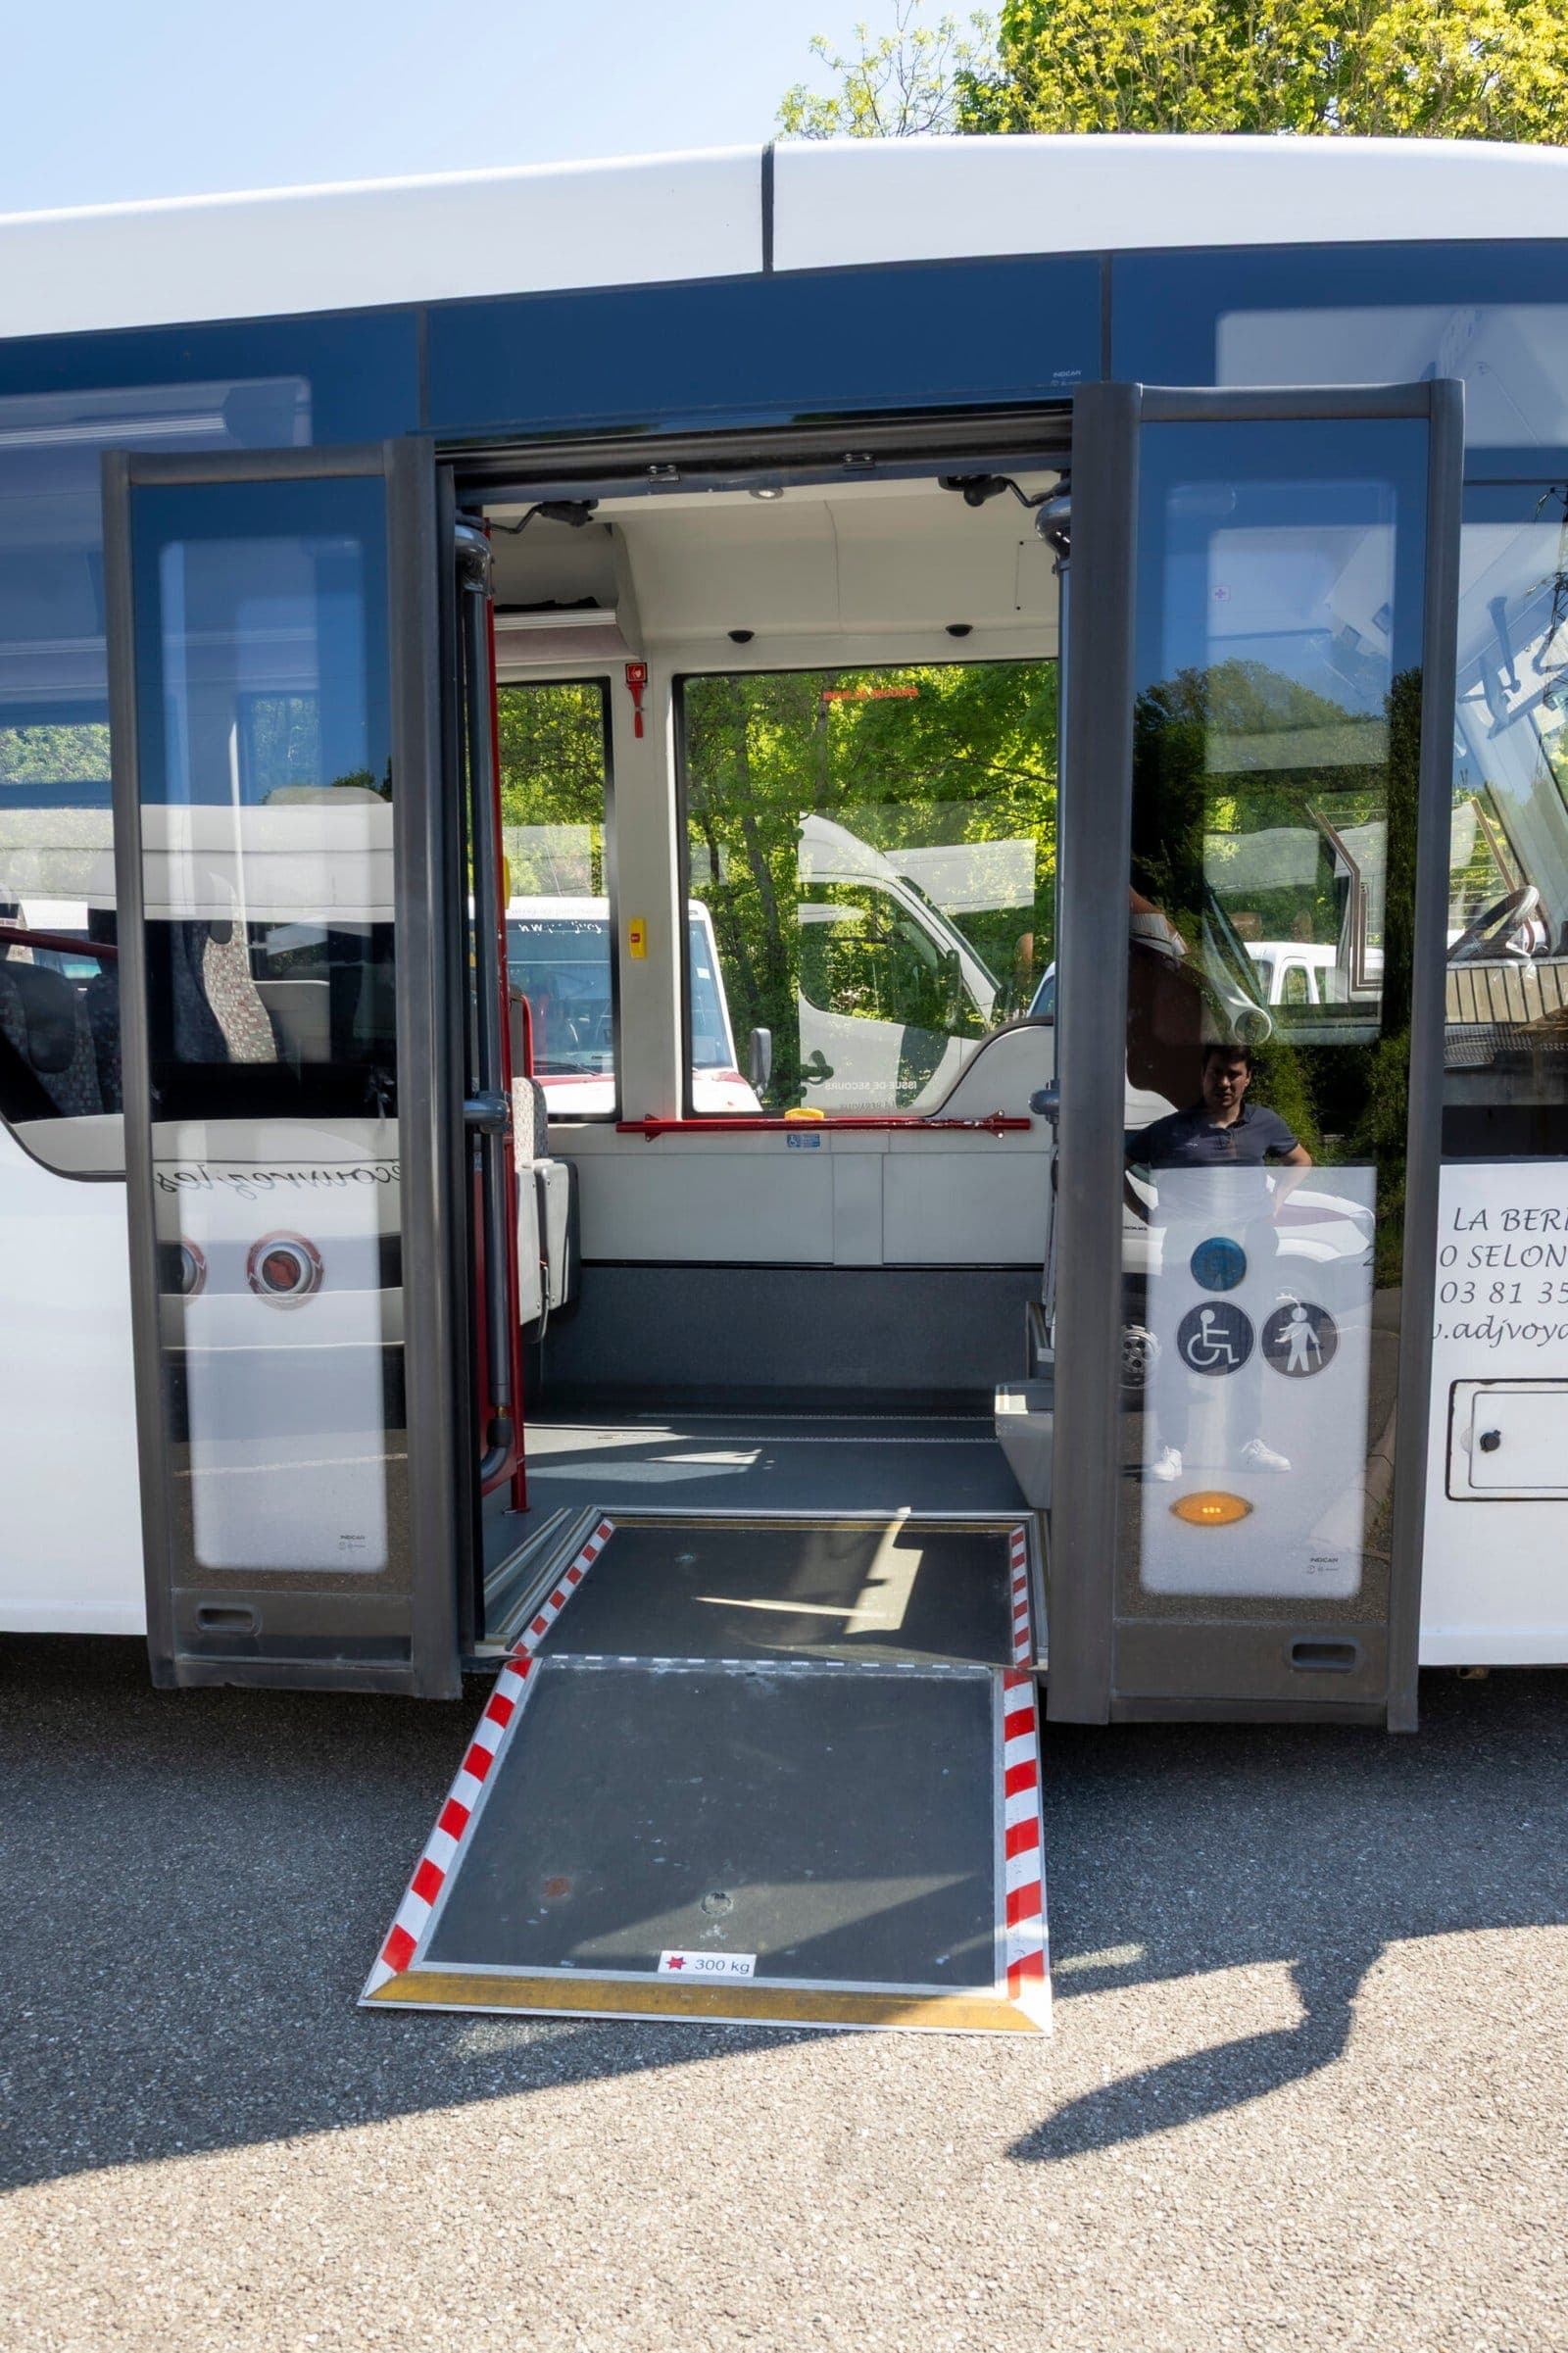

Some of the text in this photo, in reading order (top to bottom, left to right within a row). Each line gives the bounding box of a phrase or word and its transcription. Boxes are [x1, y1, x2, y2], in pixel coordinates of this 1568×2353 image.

[1453, 1207, 1568, 1232] LA BER
[1467, 1244, 1568, 1268] SELON
[1441, 1282, 1568, 1303] 03 81 35
[695, 1959, 750, 1975] 300 kg
